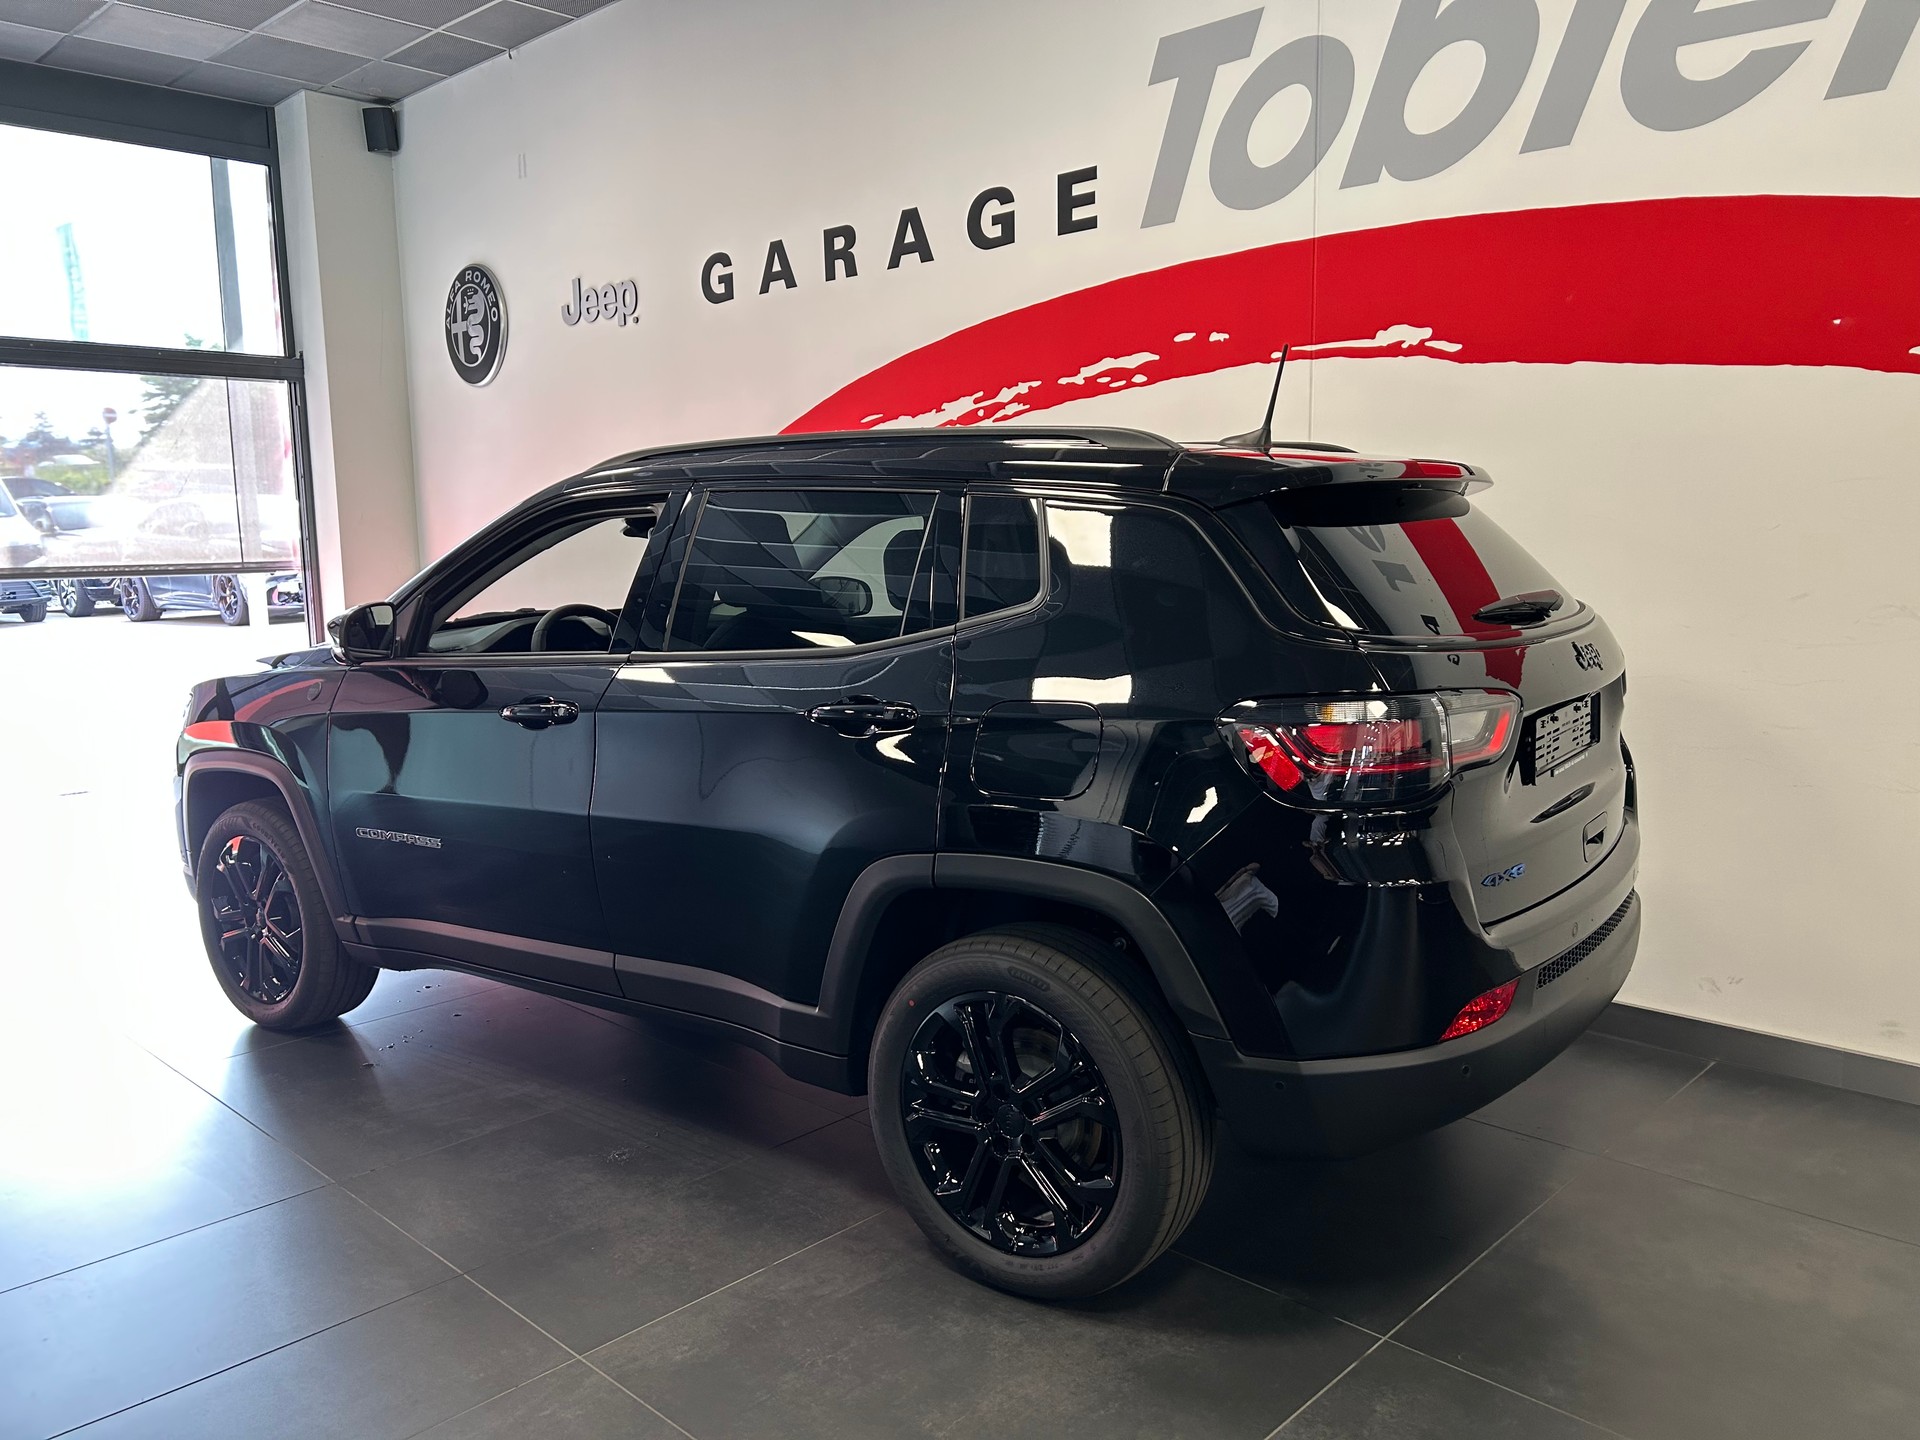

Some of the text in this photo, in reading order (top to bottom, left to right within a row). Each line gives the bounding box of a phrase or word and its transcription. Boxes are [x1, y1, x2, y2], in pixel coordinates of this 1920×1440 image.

[702, 166, 1098, 304] GARAGE
[445, 270, 499, 330] ALFA ROMEO
[355, 827, 442, 849] COMPASS
